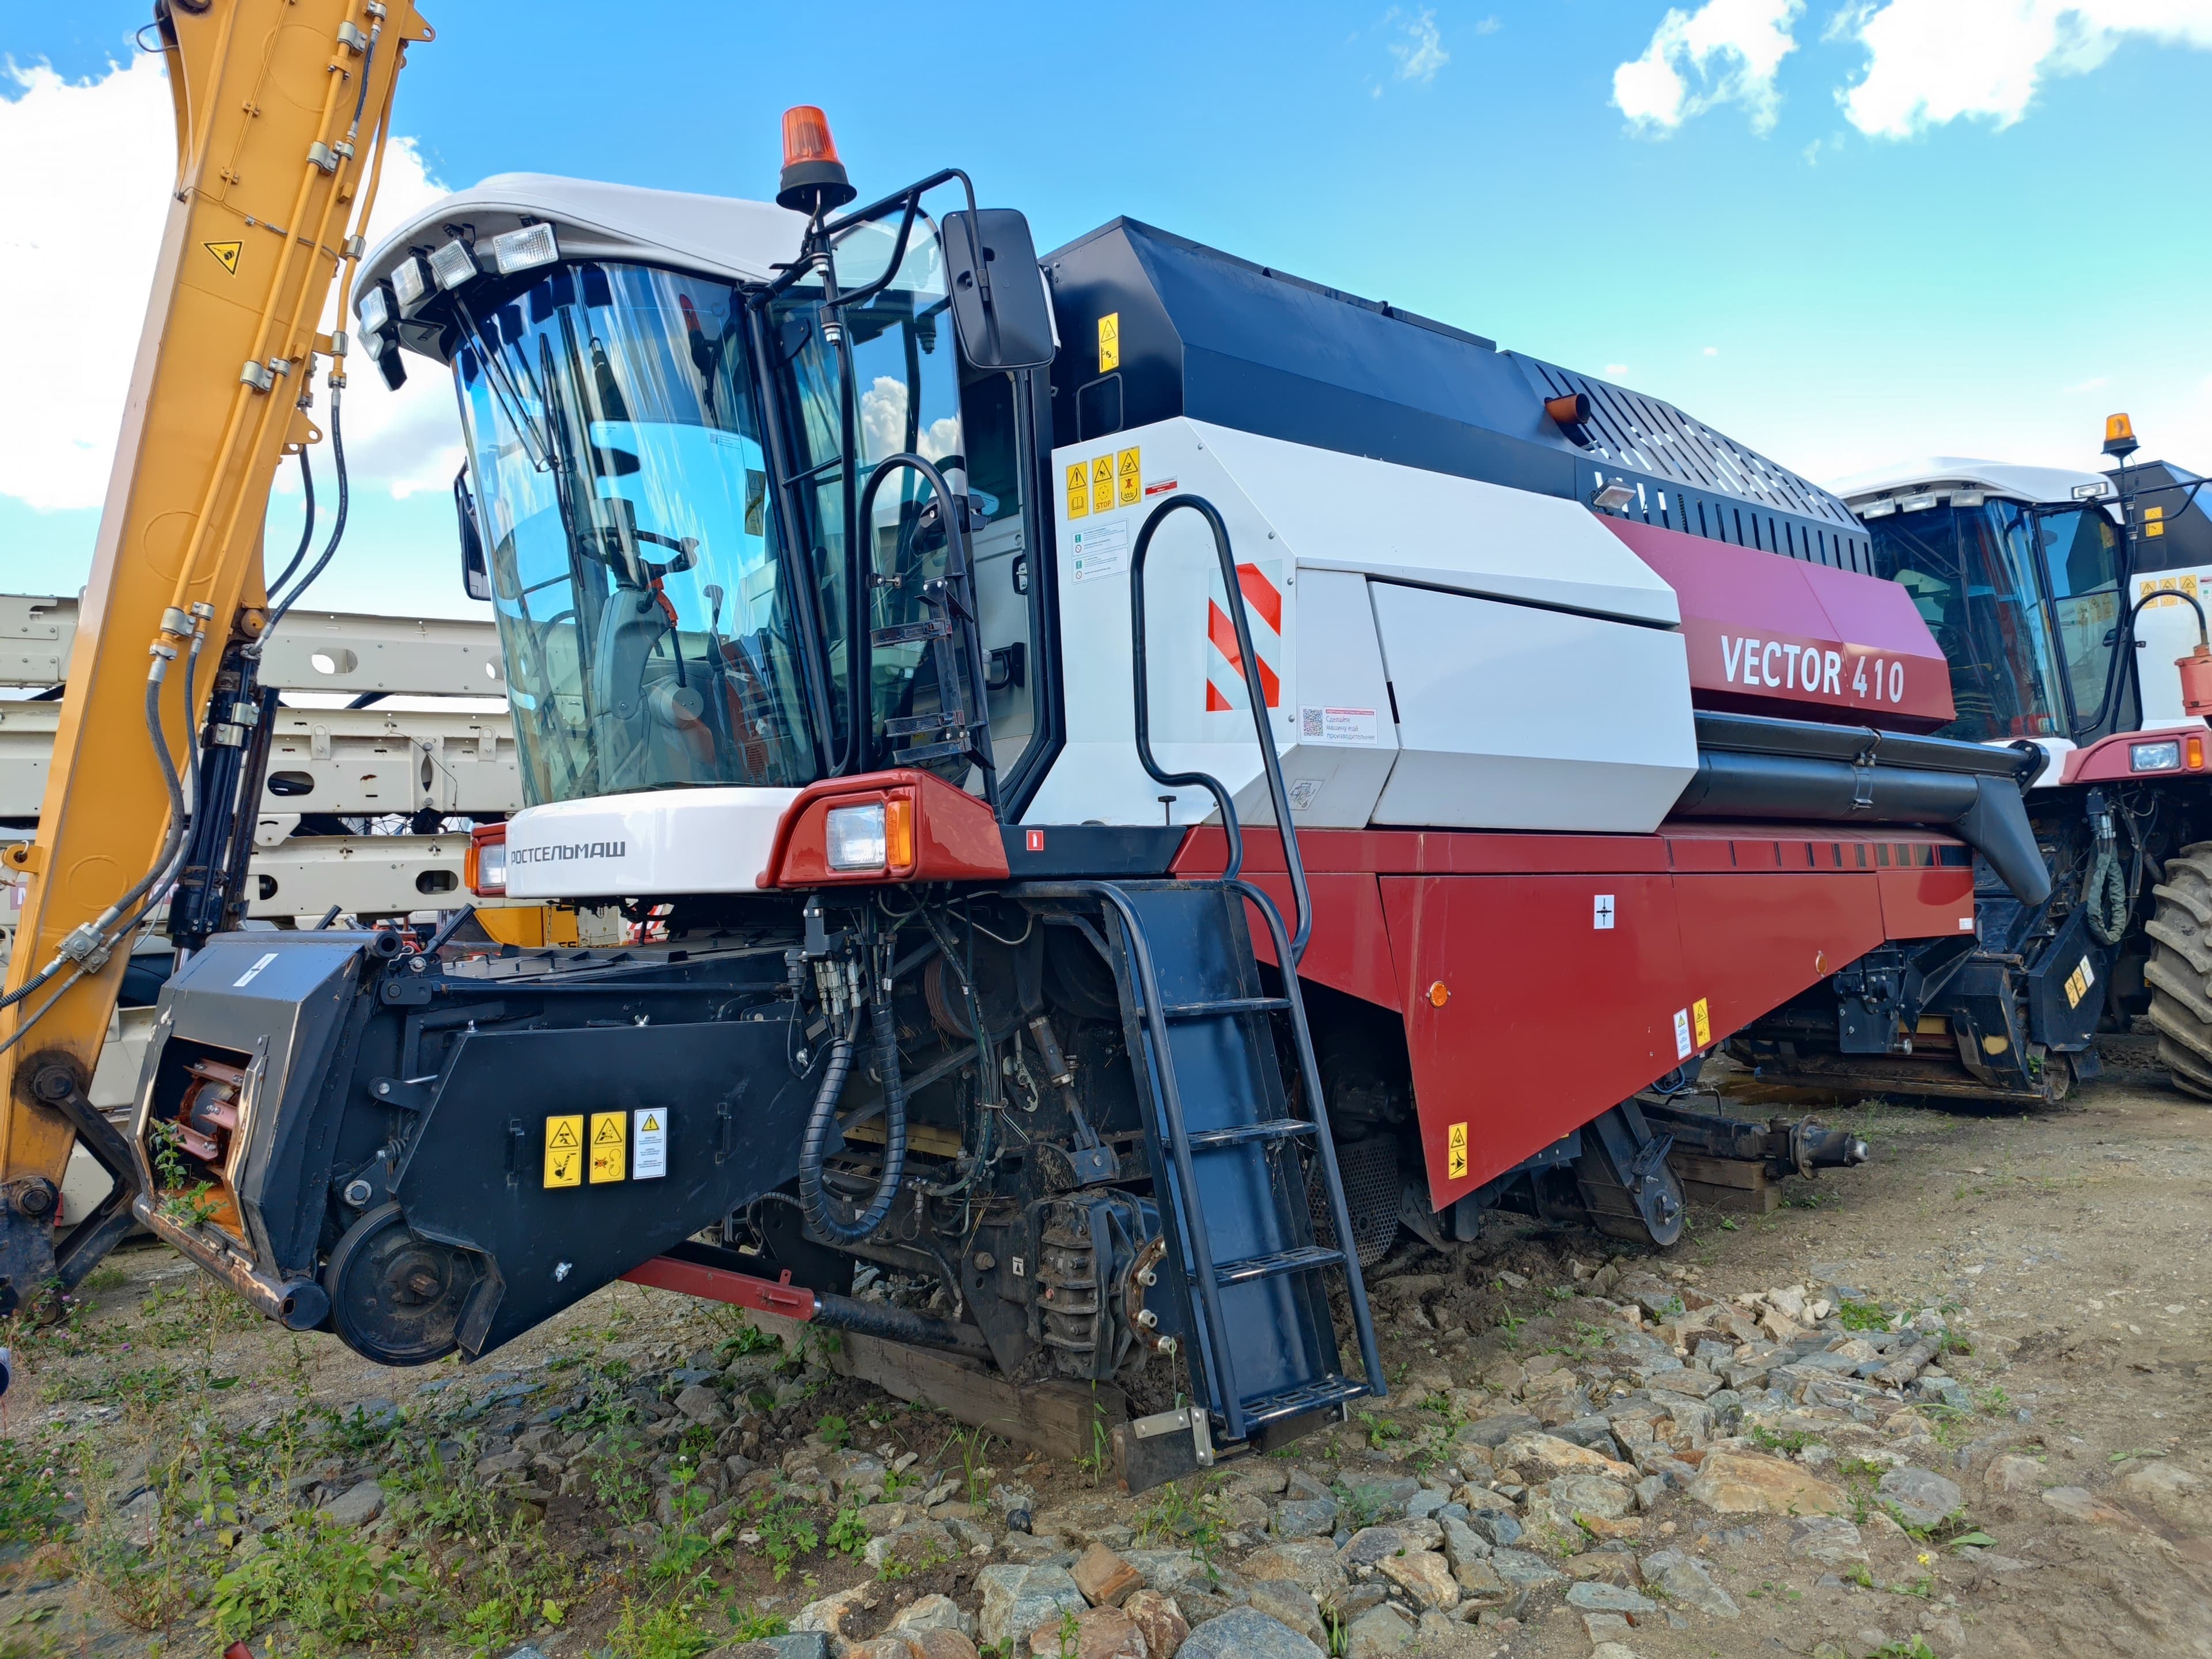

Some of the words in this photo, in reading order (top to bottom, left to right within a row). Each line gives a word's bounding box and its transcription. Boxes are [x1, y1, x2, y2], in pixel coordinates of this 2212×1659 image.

[1096, 500, 1111, 510] STOP
[1721, 635, 1842, 695] VECTOR
[1852, 656, 1904, 703] 410
[1326, 715, 1351, 724] Сделайте
[511, 841, 626, 865] РОСТСЕЛЬМАШ
